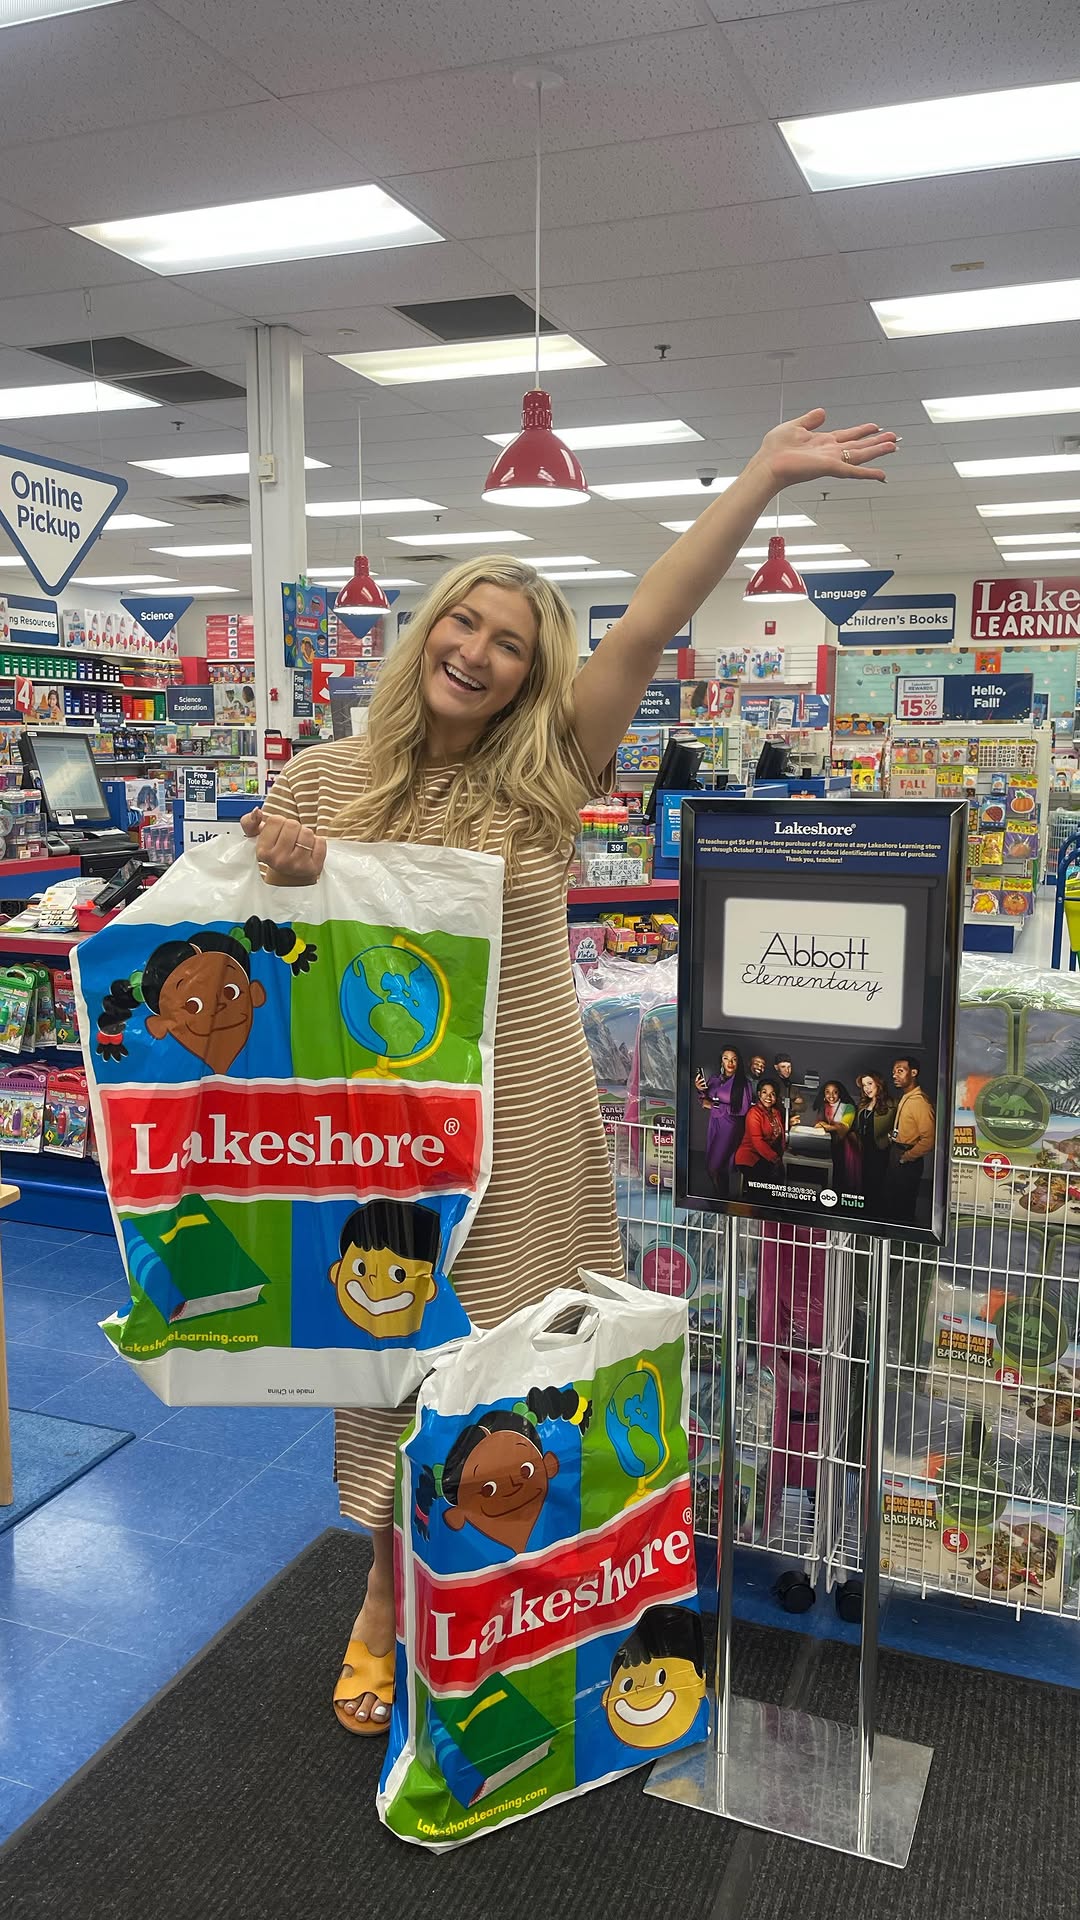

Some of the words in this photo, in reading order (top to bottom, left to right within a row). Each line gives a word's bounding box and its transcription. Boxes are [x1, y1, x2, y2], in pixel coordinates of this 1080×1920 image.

[10, 470, 83, 513] Online
[17, 504, 81, 542] Pickup
[814, 588, 867, 600] Language
[20, 615, 56, 628] Resources
[140, 611, 174, 621] Science
[846, 615, 906, 626] Children's
[909, 613, 948, 624] Books
[17, 681, 30, 710] 4
[971, 685, 1006, 697] Hello,
[711, 683, 719, 712] 2
[974, 698, 1000, 709] Fall!
[173, 703, 208, 712] Exploration
[641, 707, 660, 715] More
[901, 699, 937, 716] 15%
[187, 778, 201, 786] Tote
[201, 779, 214, 787] Bag
[900, 779, 927, 789] FALL
[705, 838, 729, 846] teachers
[867, 841, 898, 850] Lakeshore
[898, 842, 925, 851] Learning
[925, 843, 942, 851] store
[785, 855, 802, 863] Thank
[815, 856, 843, 864] teachers!
[839, 849, 879, 857] identification
[907, 851, 938, 859] purchase.
[759, 932, 870, 970] Abbott
[741, 963, 883, 1002] Elementary
[747, 1180, 787, 1192] WEDNESDAYS
[771, 1190, 798, 1200] STARTING
[798, 1193, 811, 1202] OCT
[820, 1193, 837, 1202] abc
[841, 1198, 865, 1209] hulu
[120, 1331, 259, 1353] LakeshoreLearning.com
[937, 1347, 993, 1367] BACKPACK
[1003, 1372, 1015, 1384] 8
[267, 1387, 287, 1396] China
[288, 1387, 295, 1395] in
[296, 1387, 315, 1395] made
[883, 1513, 937, 1529] BACKPACK
[949, 1533, 960, 1547] 8
